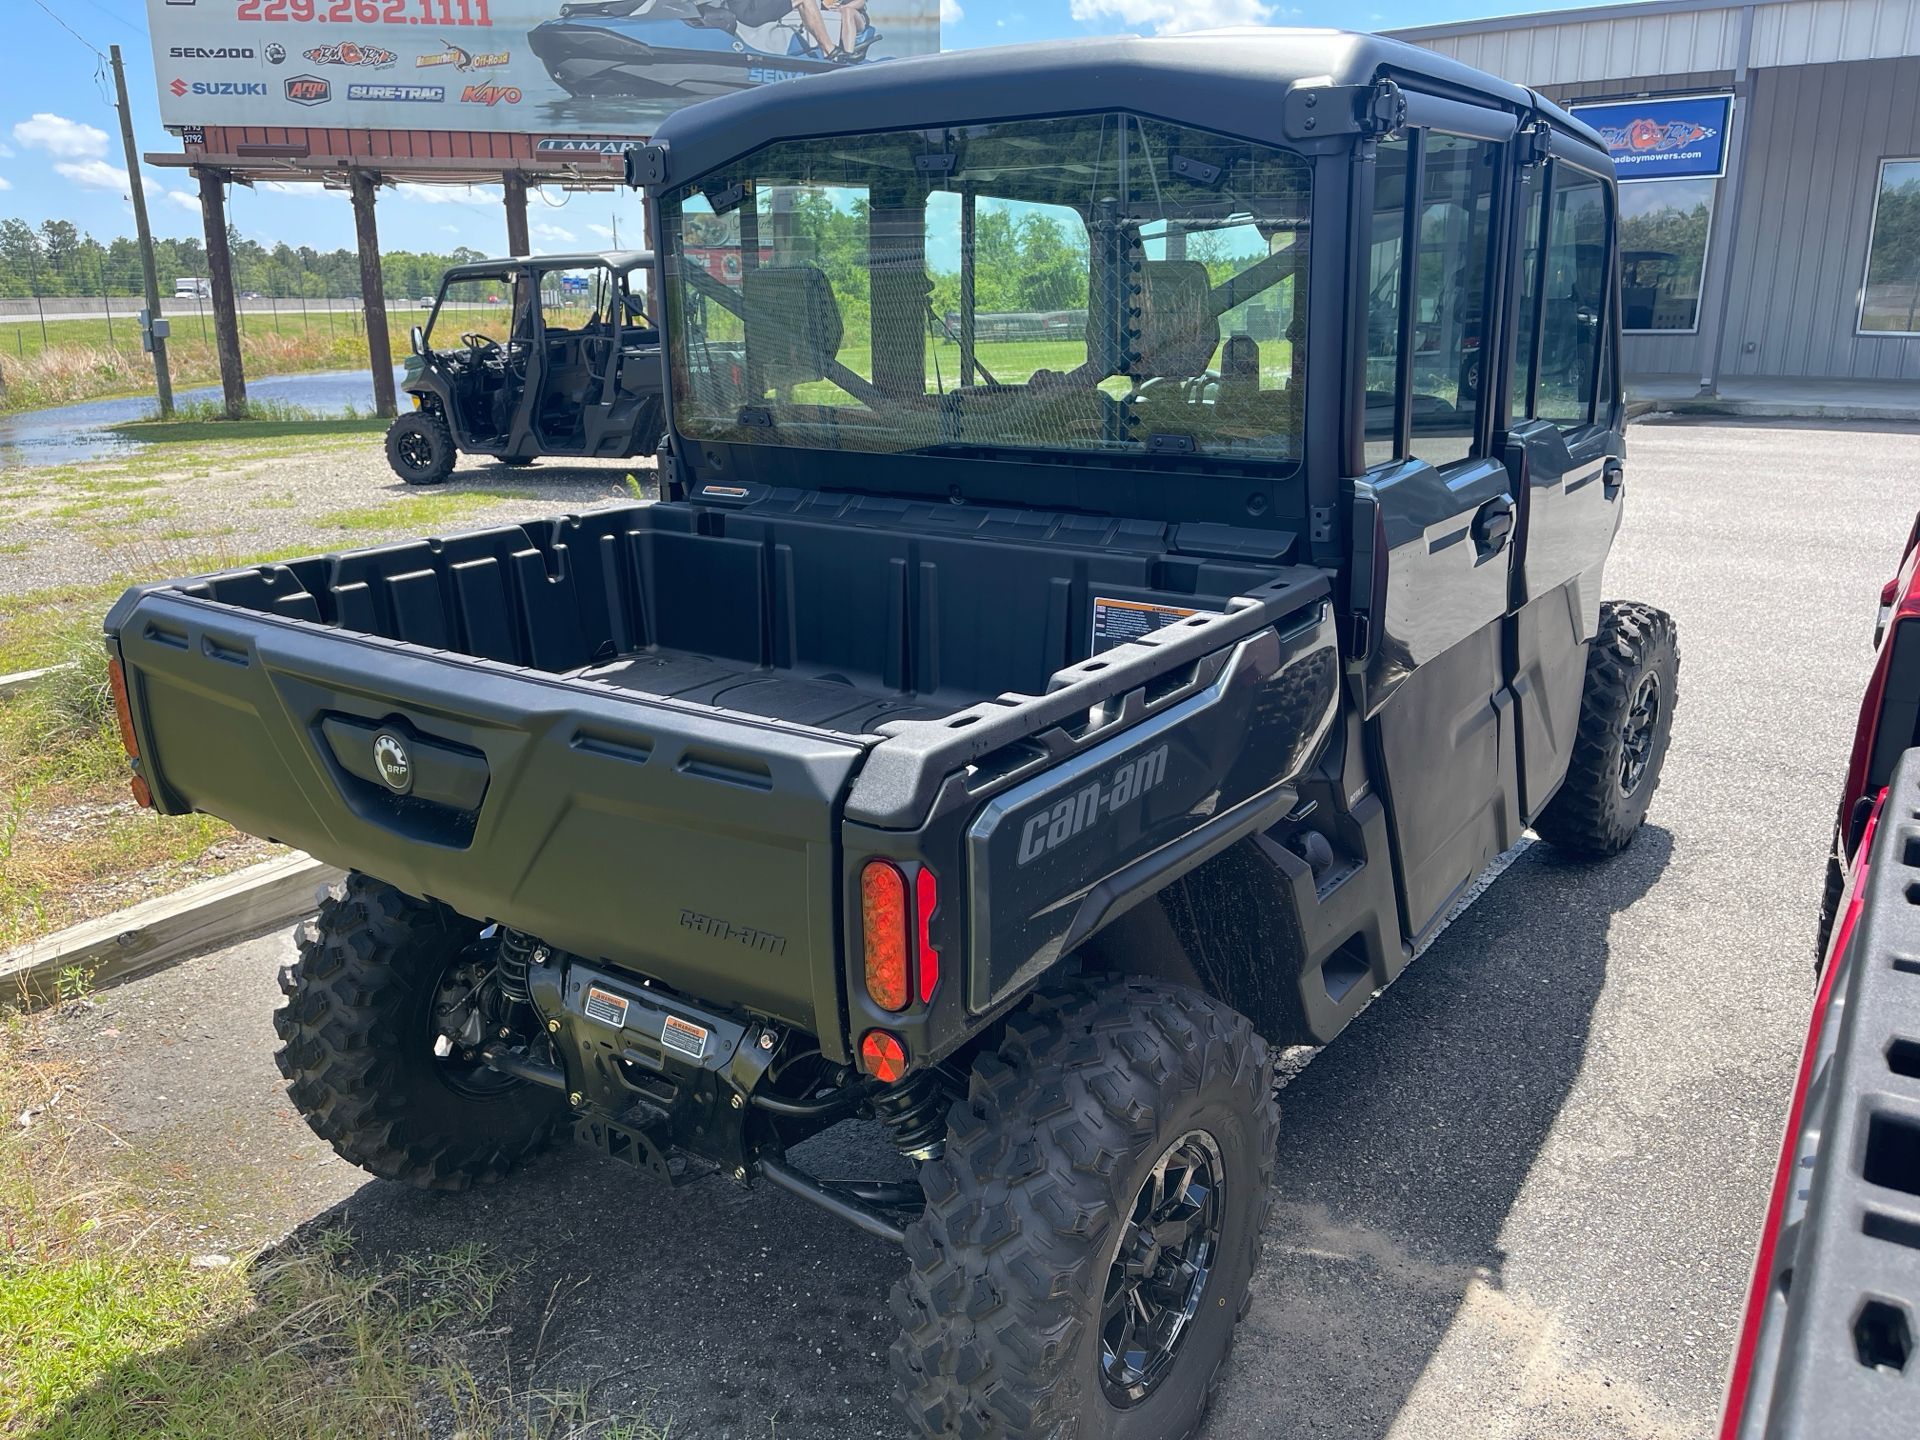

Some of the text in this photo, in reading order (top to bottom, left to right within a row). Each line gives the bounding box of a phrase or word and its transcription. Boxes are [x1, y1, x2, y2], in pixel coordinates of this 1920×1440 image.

[237, 0, 494, 27] 229.262.1111
[192, 82, 267, 96] SUZUKI
[289, 82, 327, 99] Argo
[350, 85, 443, 101] SURE-TRAC
[461, 80, 522, 106] KAYO
[184, 134, 203, 144] 3792
[387, 764, 407, 775] BRP
[1018, 744, 1169, 866] can-am
[680, 908, 787, 956] can-am
